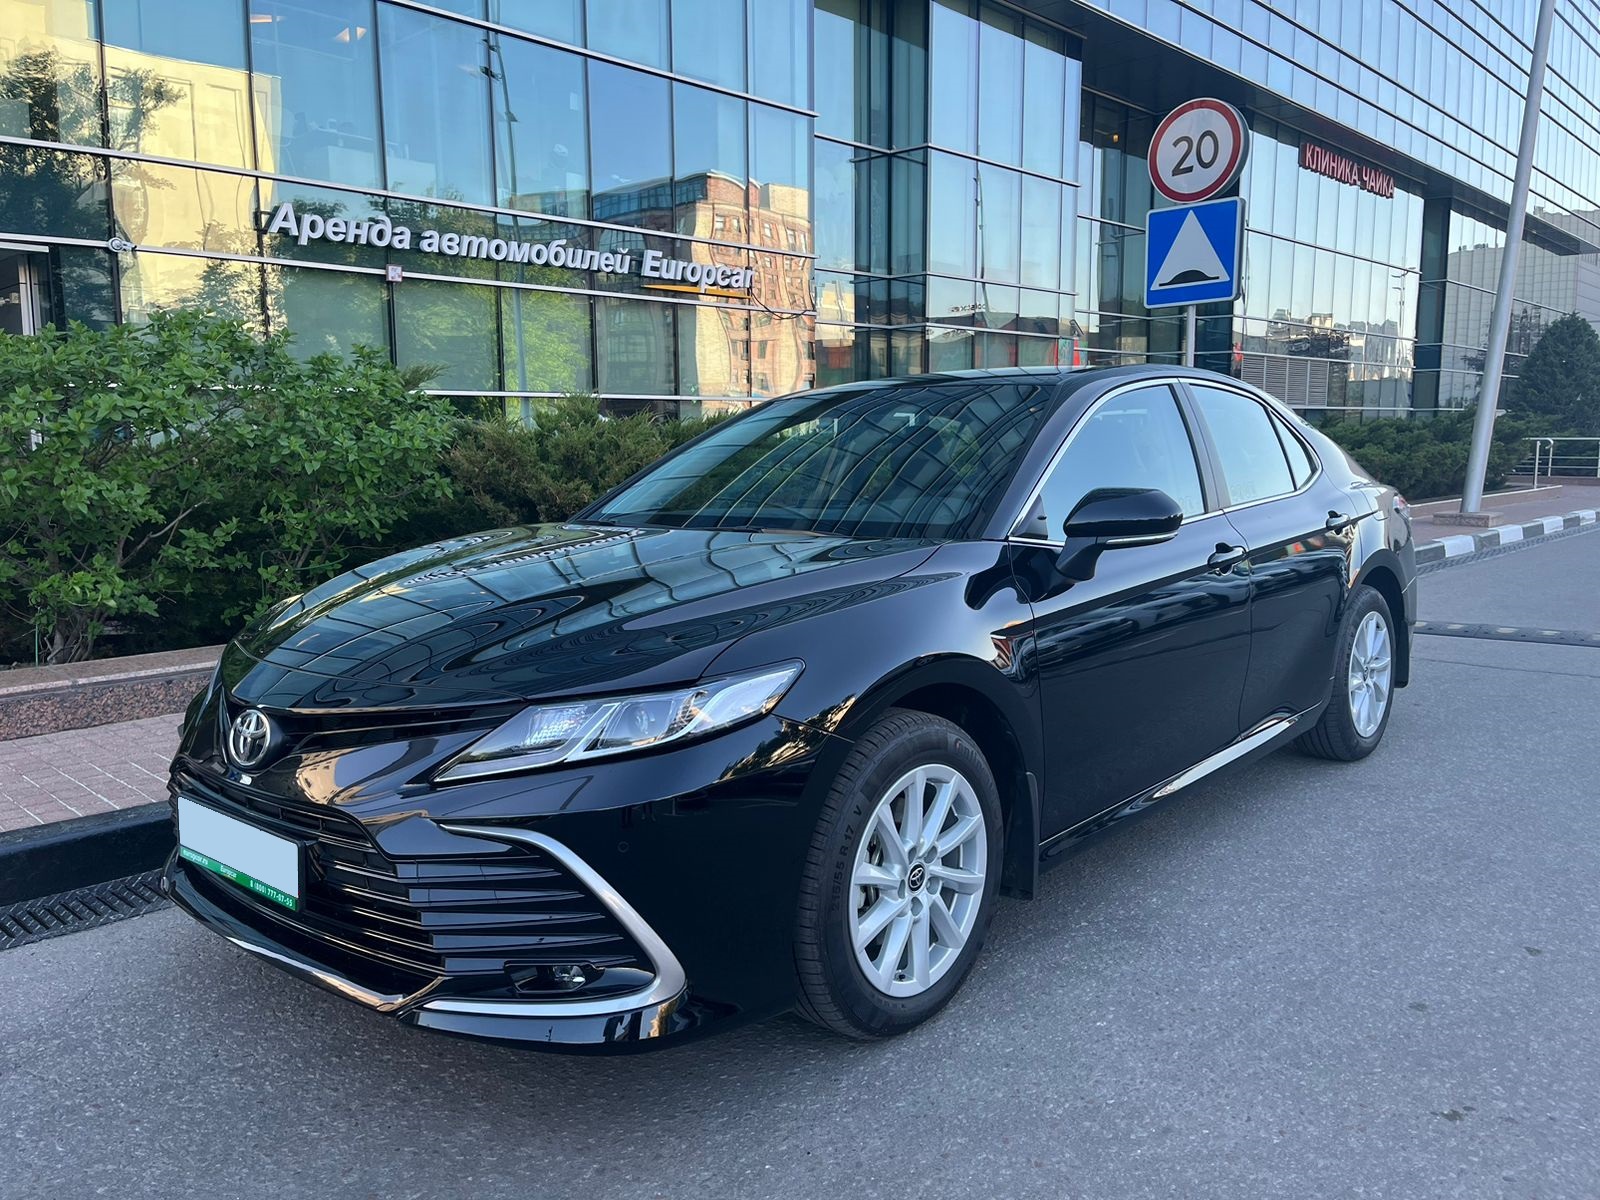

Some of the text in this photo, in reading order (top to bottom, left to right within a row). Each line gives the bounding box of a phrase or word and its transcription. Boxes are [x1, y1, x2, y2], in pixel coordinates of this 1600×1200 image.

[1172, 130, 1219, 176] 20
[1305, 142, 1395, 198] КЛИНИКА ЧАЙКА
[268, 201, 755, 293] Аренда автомобилей Europcar
